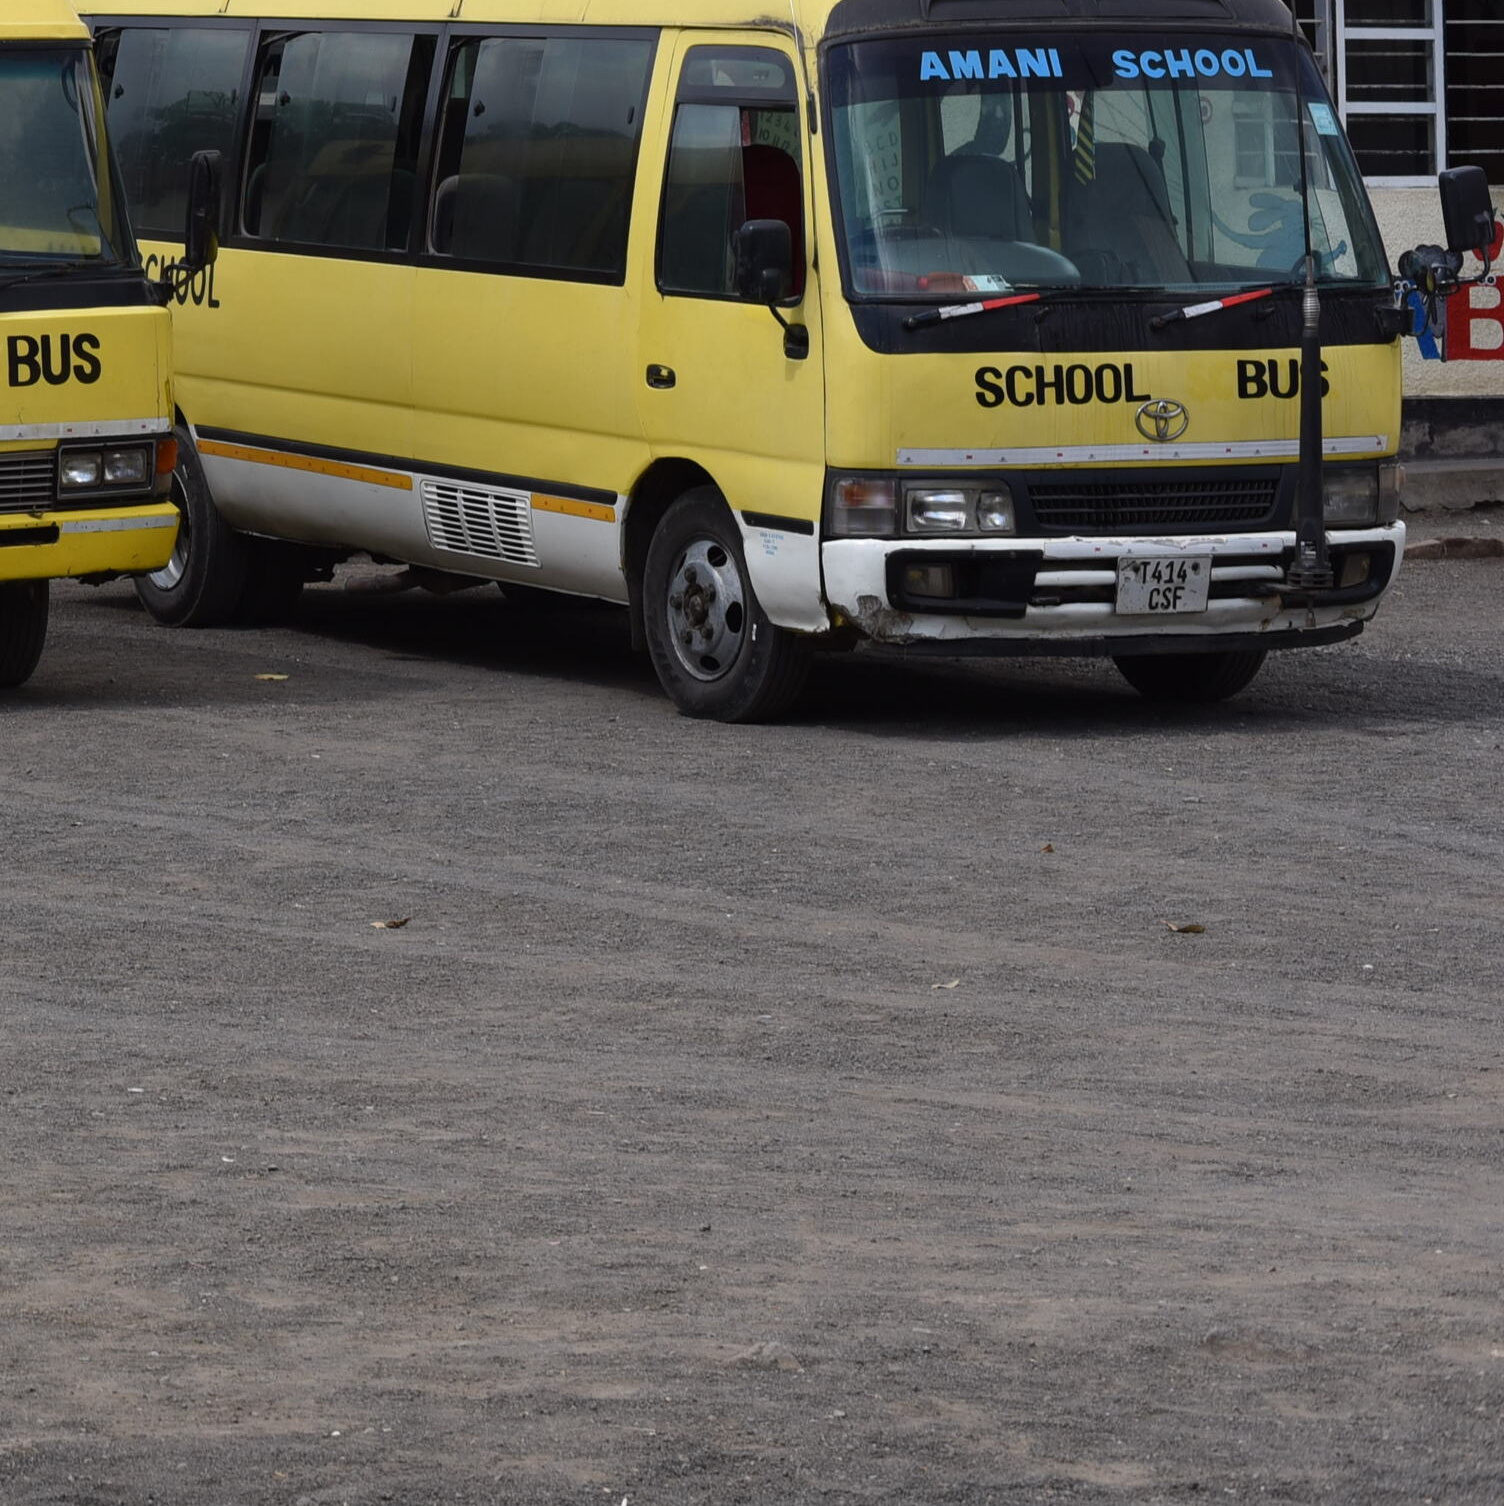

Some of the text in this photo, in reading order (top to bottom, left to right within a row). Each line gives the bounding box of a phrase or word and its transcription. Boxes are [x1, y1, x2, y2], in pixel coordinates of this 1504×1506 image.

[920, 47, 1273, 81] AMANI SCHOOL
[6, 332, 102, 388] BUS
[974, 362, 1152, 408] SCHOOL
[1148, 586, 1185, 611] CSF
